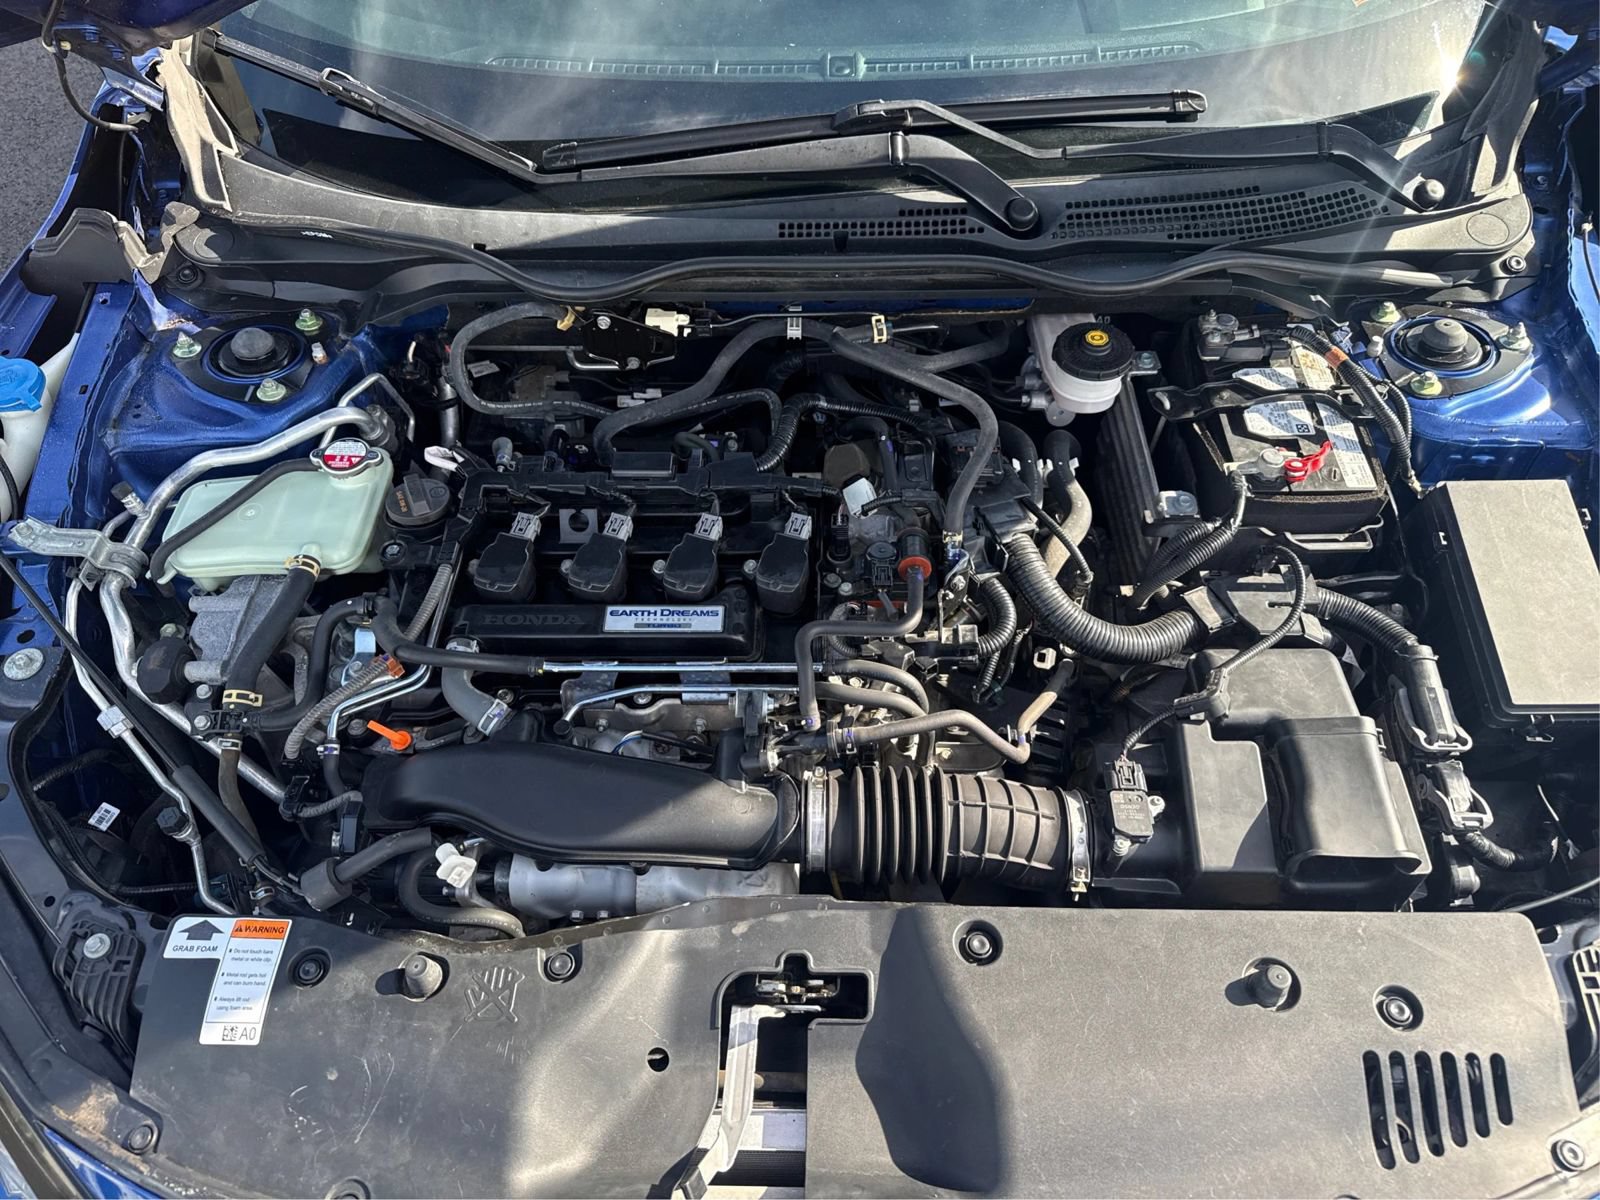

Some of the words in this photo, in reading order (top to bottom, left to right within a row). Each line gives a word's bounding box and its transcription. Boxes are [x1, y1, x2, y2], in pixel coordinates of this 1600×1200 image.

[609, 609, 658, 617] EARTH
[660, 608, 720, 617] DREAMS
[482, 614, 585, 626] HONDA
[244, 925, 285, 934] WARNING
[172, 945, 195, 953] GRAB
[196, 945, 218, 953] FOAM
[239, 1027, 257, 1040] A0
